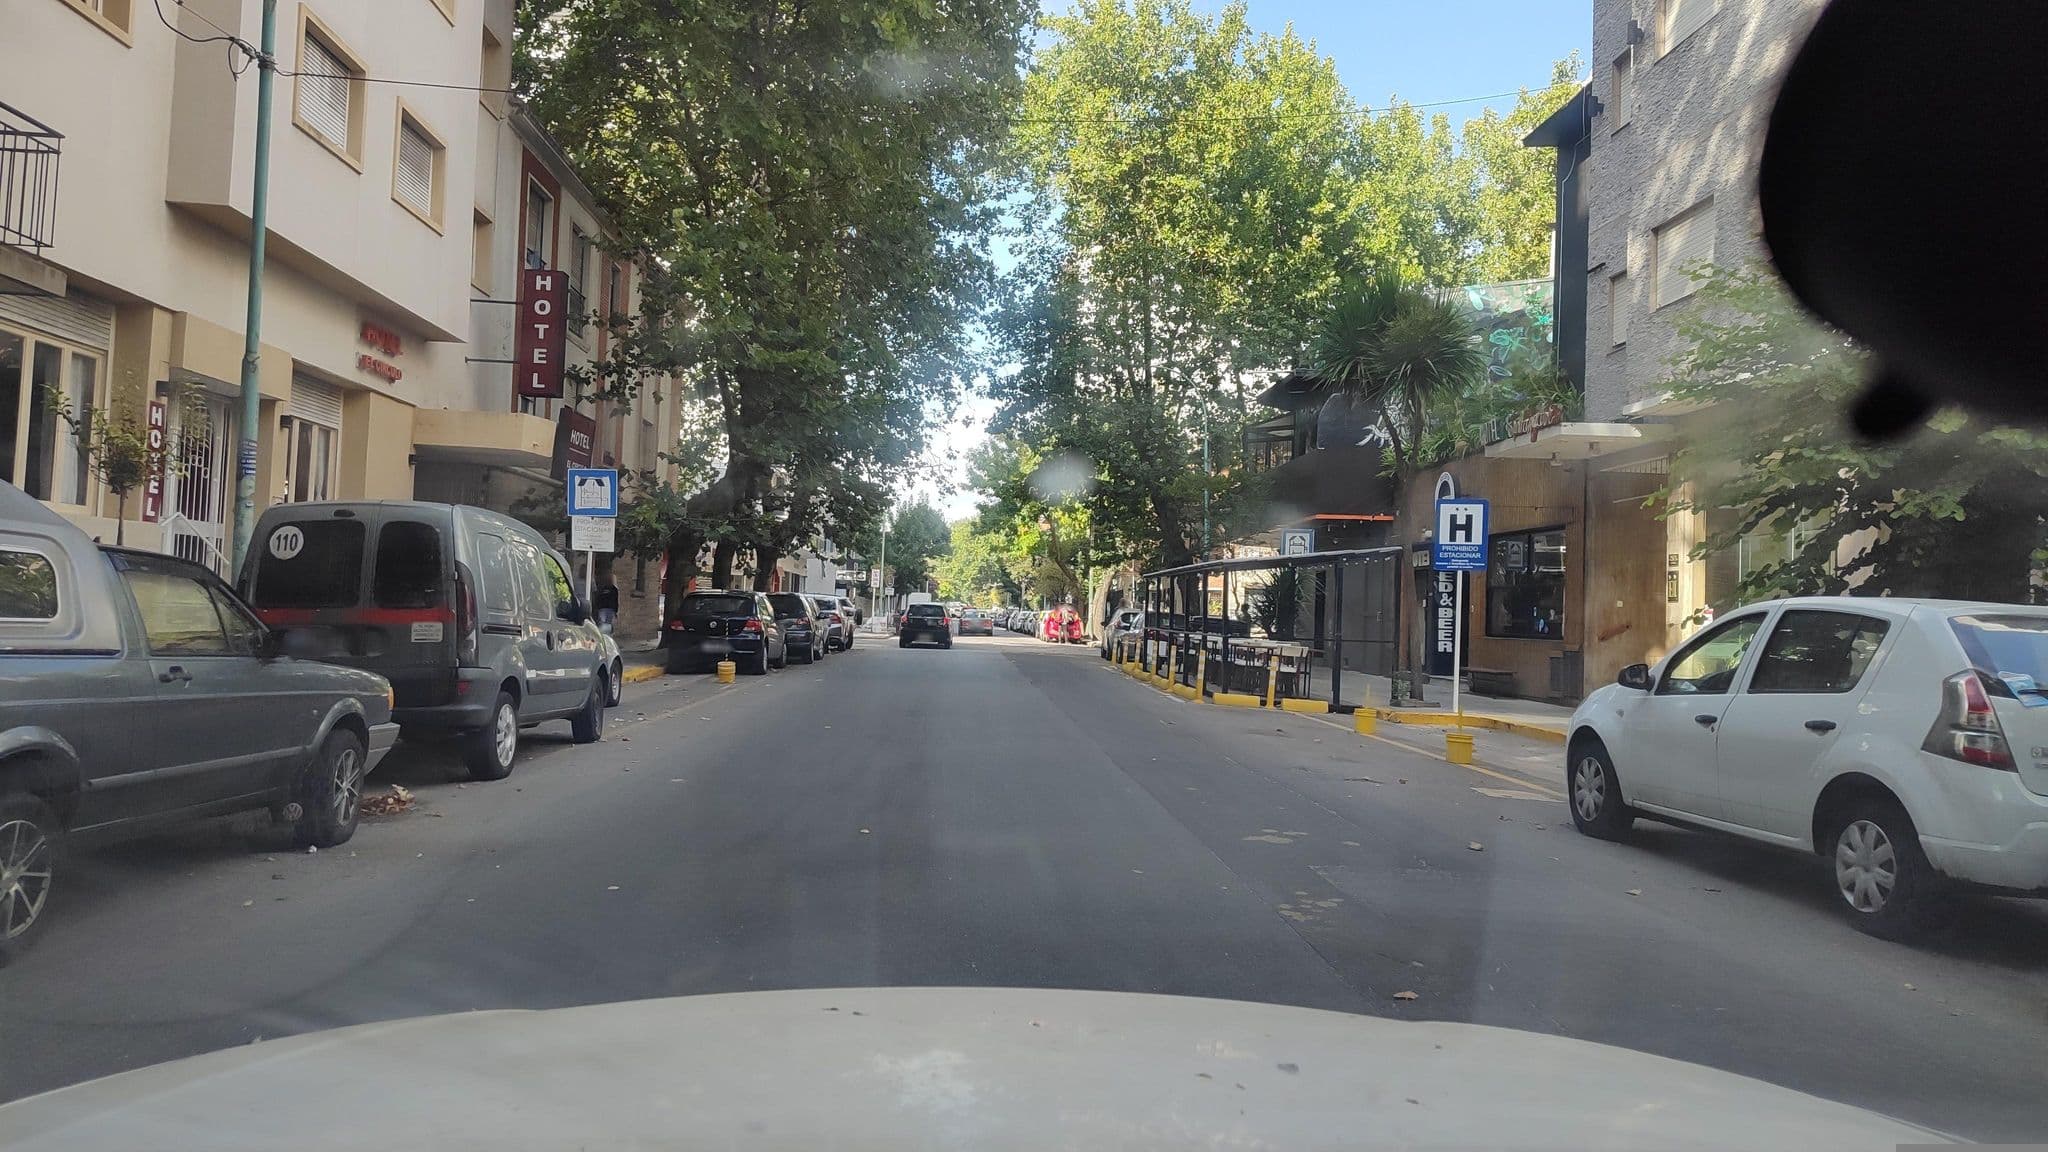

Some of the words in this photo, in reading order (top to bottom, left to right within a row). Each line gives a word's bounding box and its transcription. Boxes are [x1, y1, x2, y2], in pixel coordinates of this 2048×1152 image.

[532, 275, 552, 388] HOTEL
[570, 429, 590, 449] HOTEL
[146, 406, 162, 517] HOTEL
[276, 533, 298, 551] 110
[1449, 514, 1473, 542] H
